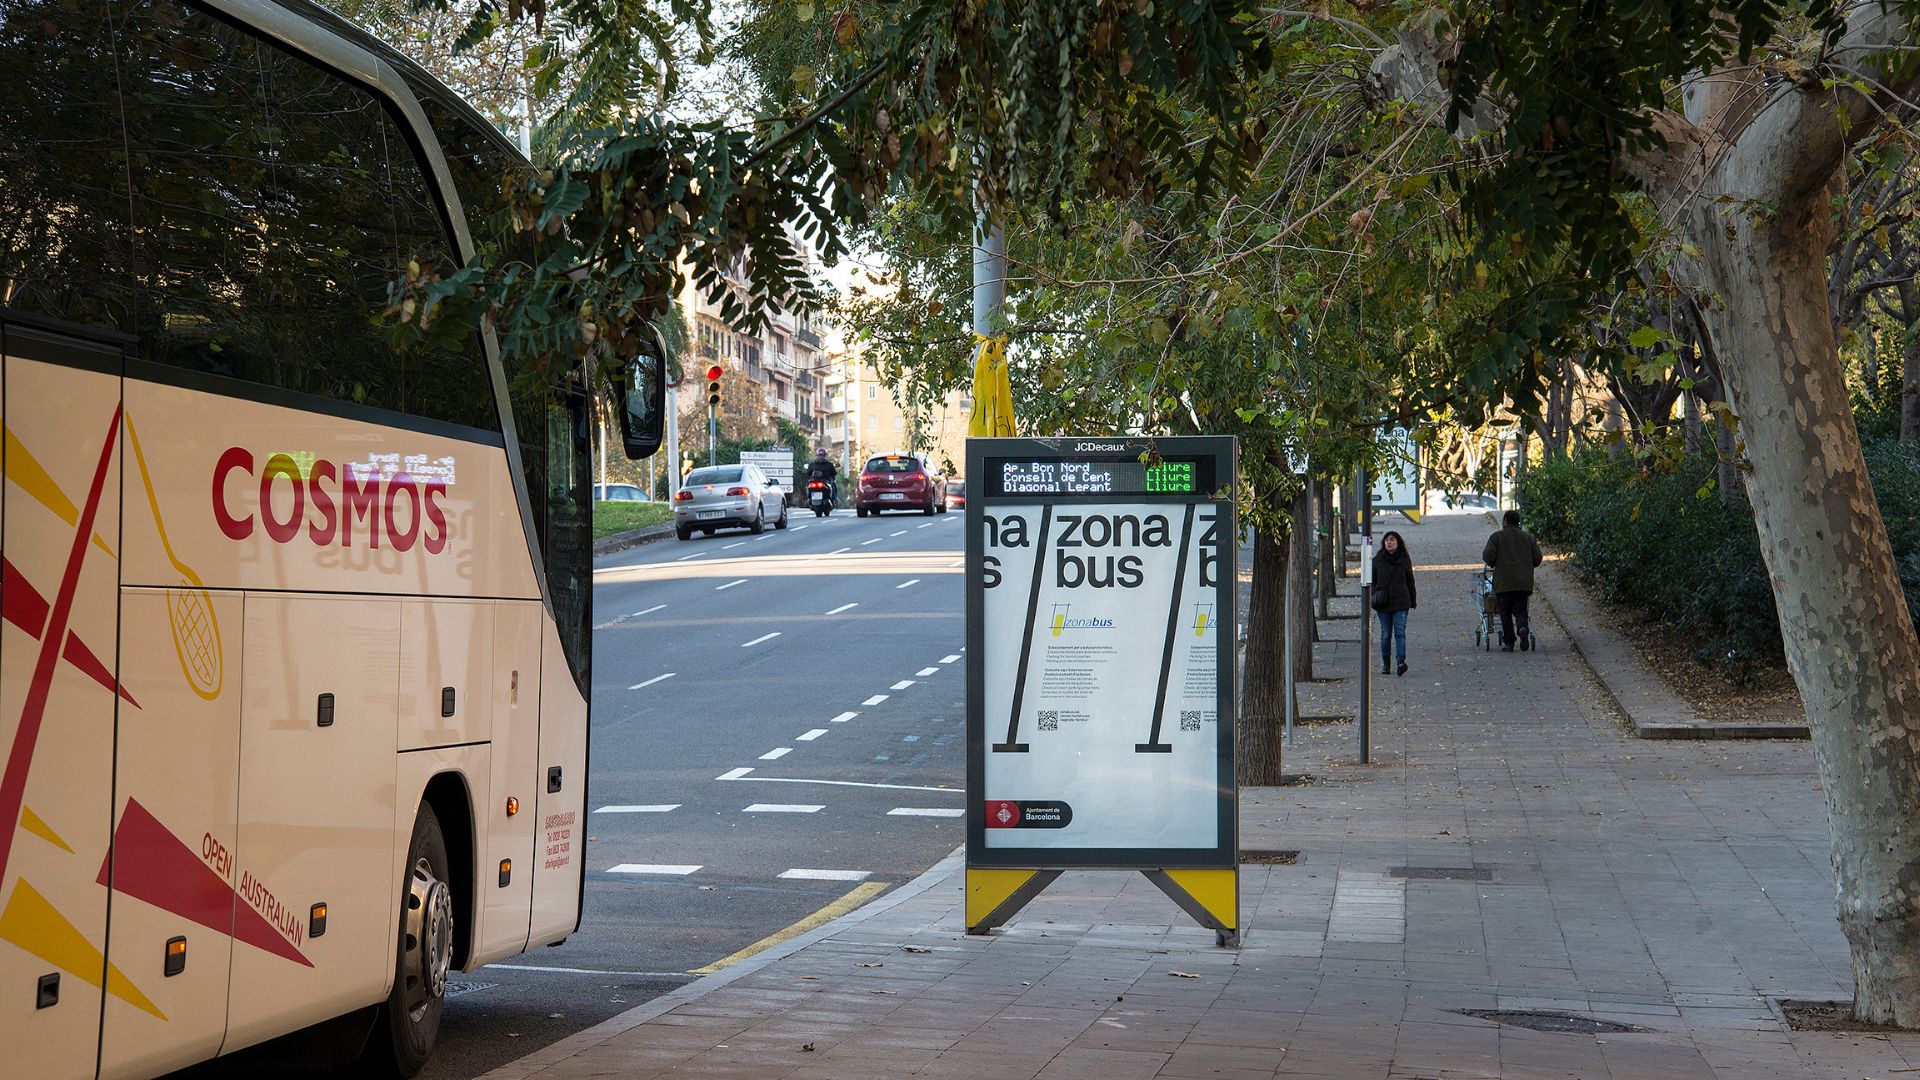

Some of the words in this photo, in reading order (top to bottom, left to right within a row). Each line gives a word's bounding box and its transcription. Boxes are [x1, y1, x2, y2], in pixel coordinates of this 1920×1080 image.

[1074, 442, 1125, 452] JCDecaux
[1003, 463, 1025, 473] Ap.
[1033, 463, 1054, 473] Bon
[1061, 462, 1090, 473] Nord
[1003, 473, 1053, 482] Consell
[1061, 473, 1076, 482] de
[1082, 473, 1112, 482] Cent
[1146, 472, 1191, 482] Lliure
[1003, 482, 1061, 492] Diagonal
[1068, 482, 1112, 492] Lepant
[1146, 482, 1191, 492] Lliure
[212, 446, 447, 555] COSMOS
[1056, 514, 1172, 548] zona
[1056, 549, 1144, 589] bus
[1065, 617, 1113, 628] zonabus
[202, 832, 233, 880] OPEN
[240, 870, 304, 947] AUSTRALIAN
